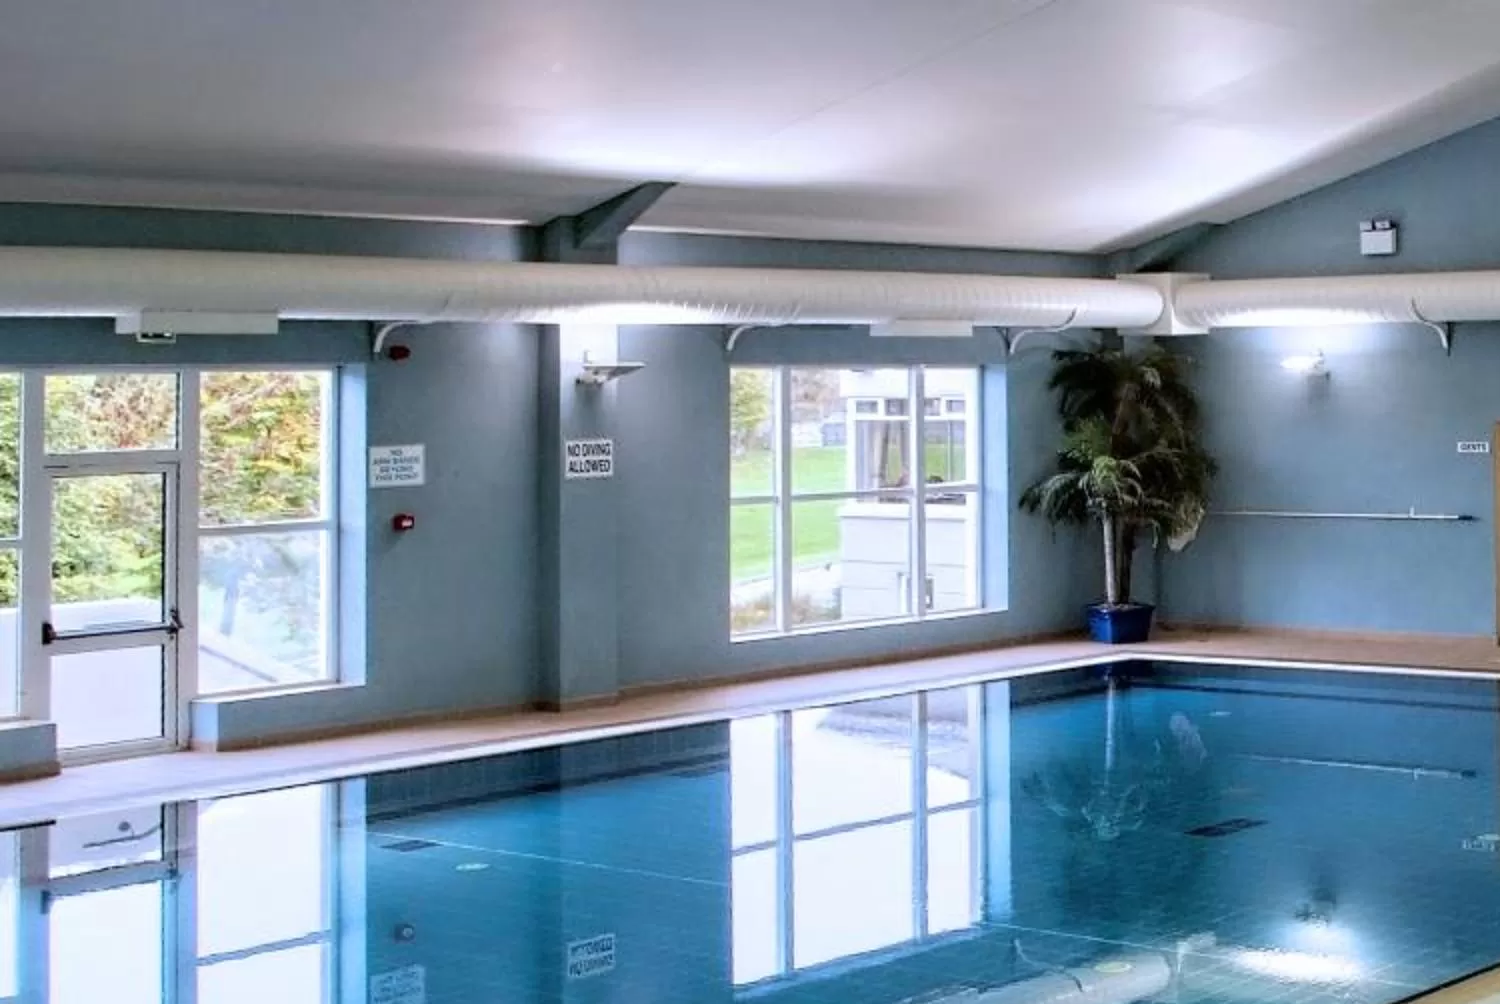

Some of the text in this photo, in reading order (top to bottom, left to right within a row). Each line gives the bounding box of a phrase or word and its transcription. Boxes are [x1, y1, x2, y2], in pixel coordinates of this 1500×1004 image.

[567, 443, 611, 456] NO DIVING
[569, 460, 611, 472] ALLOWED
